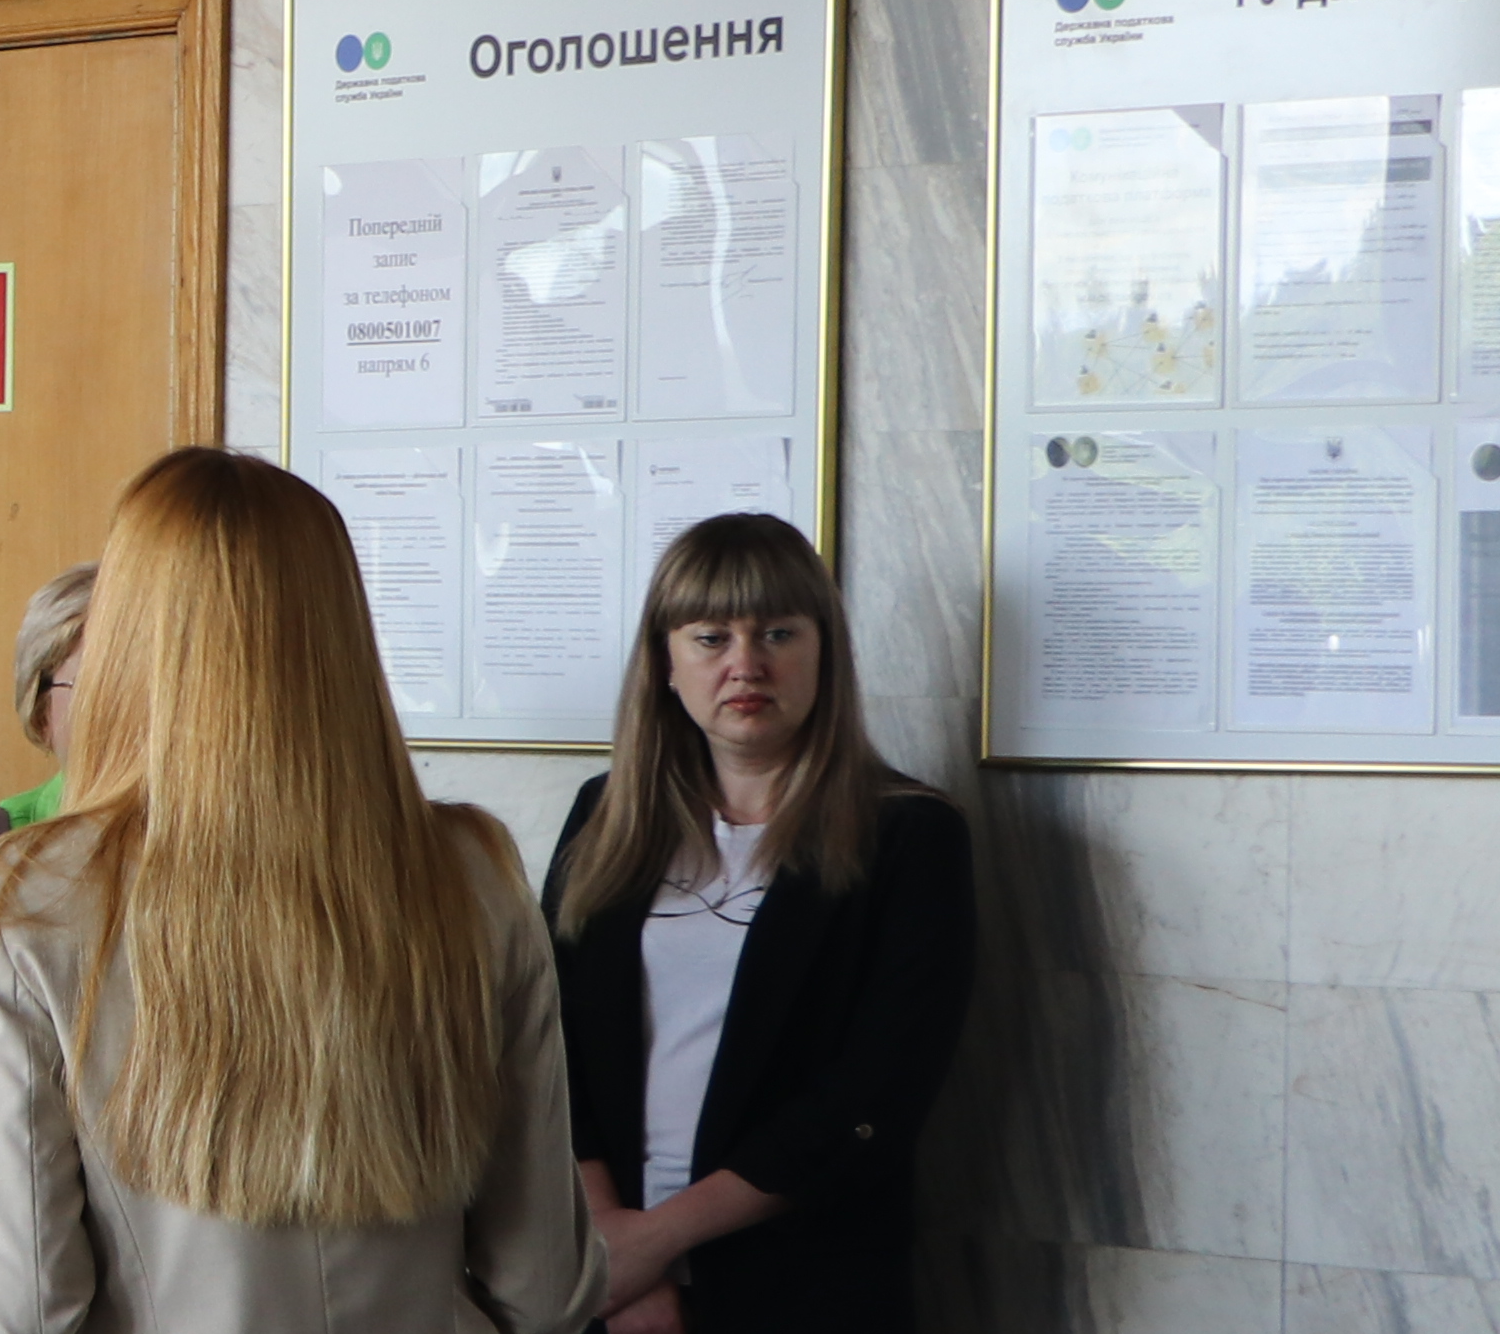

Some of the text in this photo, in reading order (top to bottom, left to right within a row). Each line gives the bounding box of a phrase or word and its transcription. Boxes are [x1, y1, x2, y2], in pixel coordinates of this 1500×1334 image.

[469, 15, 784, 79] Оголошення
[348, 214, 442, 239] Попередній
[373, 252, 417, 268] запис
[343, 284, 451, 308] за телефоном
[347, 320, 442, 342] 0800501007
[357, 353, 430, 378] напрям 6
